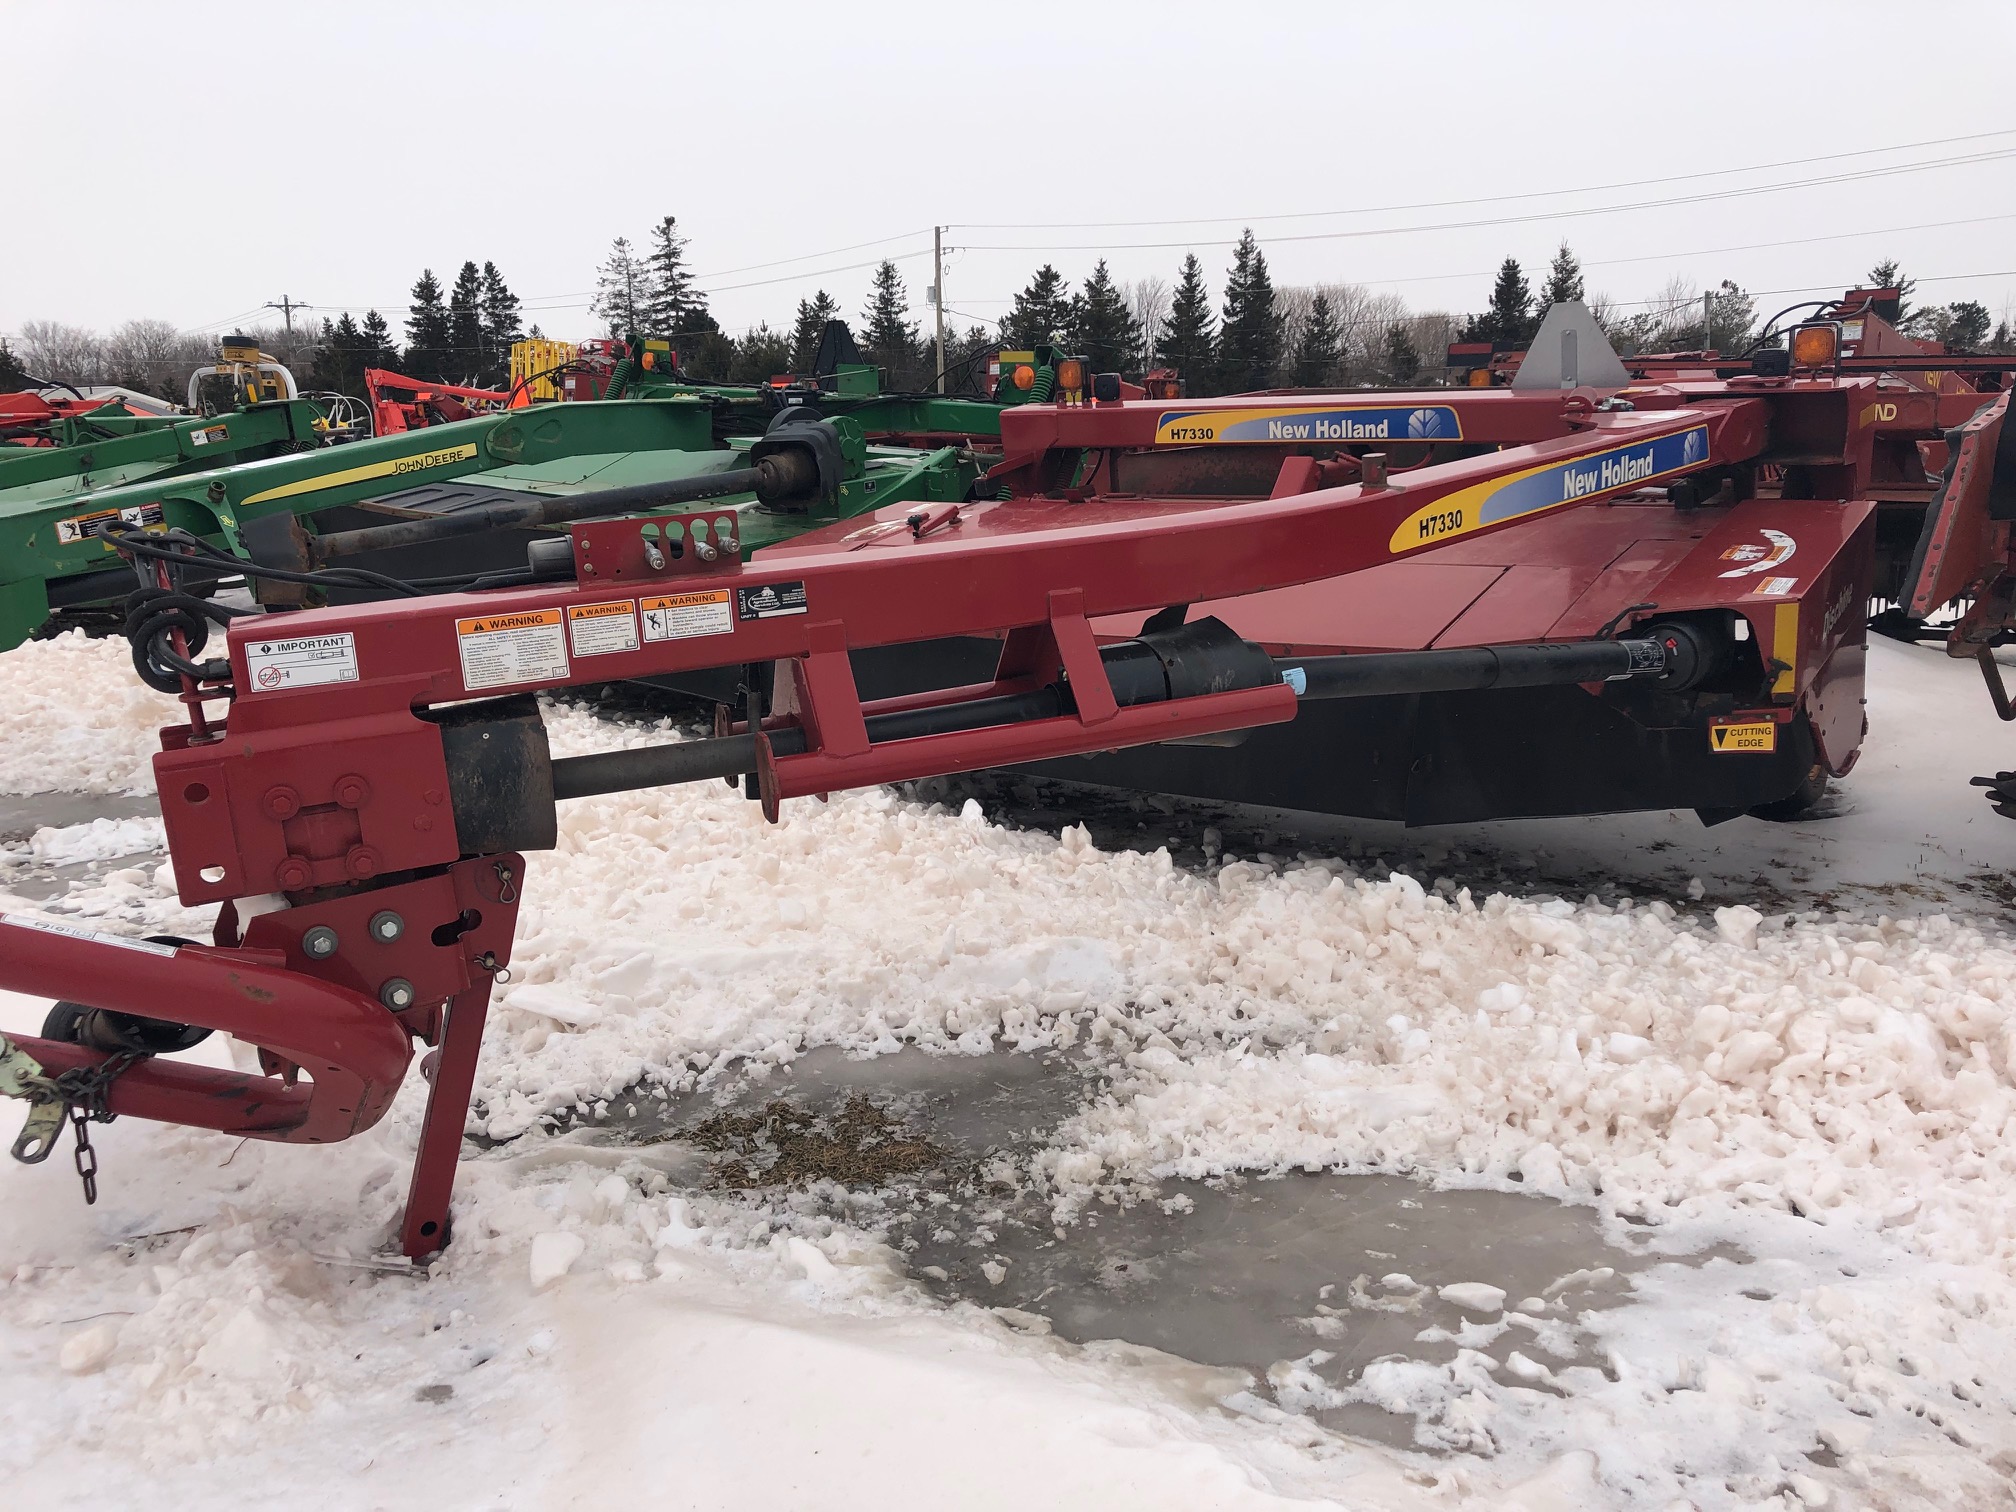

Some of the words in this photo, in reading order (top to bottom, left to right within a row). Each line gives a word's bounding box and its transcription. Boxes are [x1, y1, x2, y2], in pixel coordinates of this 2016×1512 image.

[1170, 428, 1214, 440] H7330
[1268, 420, 1309, 439] New
[1315, 419, 1389, 439] Holland
[392, 459, 424, 474] JOHN
[425, 450, 464, 467] DEERE
[1419, 509, 1463, 538] H7330
[1563, 467, 1598, 500] New
[1601, 448, 1654, 489] Holland
[669, 594, 716, 605] WARNING
[585, 605, 628, 616] WARNING
[489, 615, 544, 629] WARNING
[277, 637, 345, 652] IMPORTANT
[1730, 727, 1772, 737] CUTTING
[1737, 739, 1764, 747] EDGE
